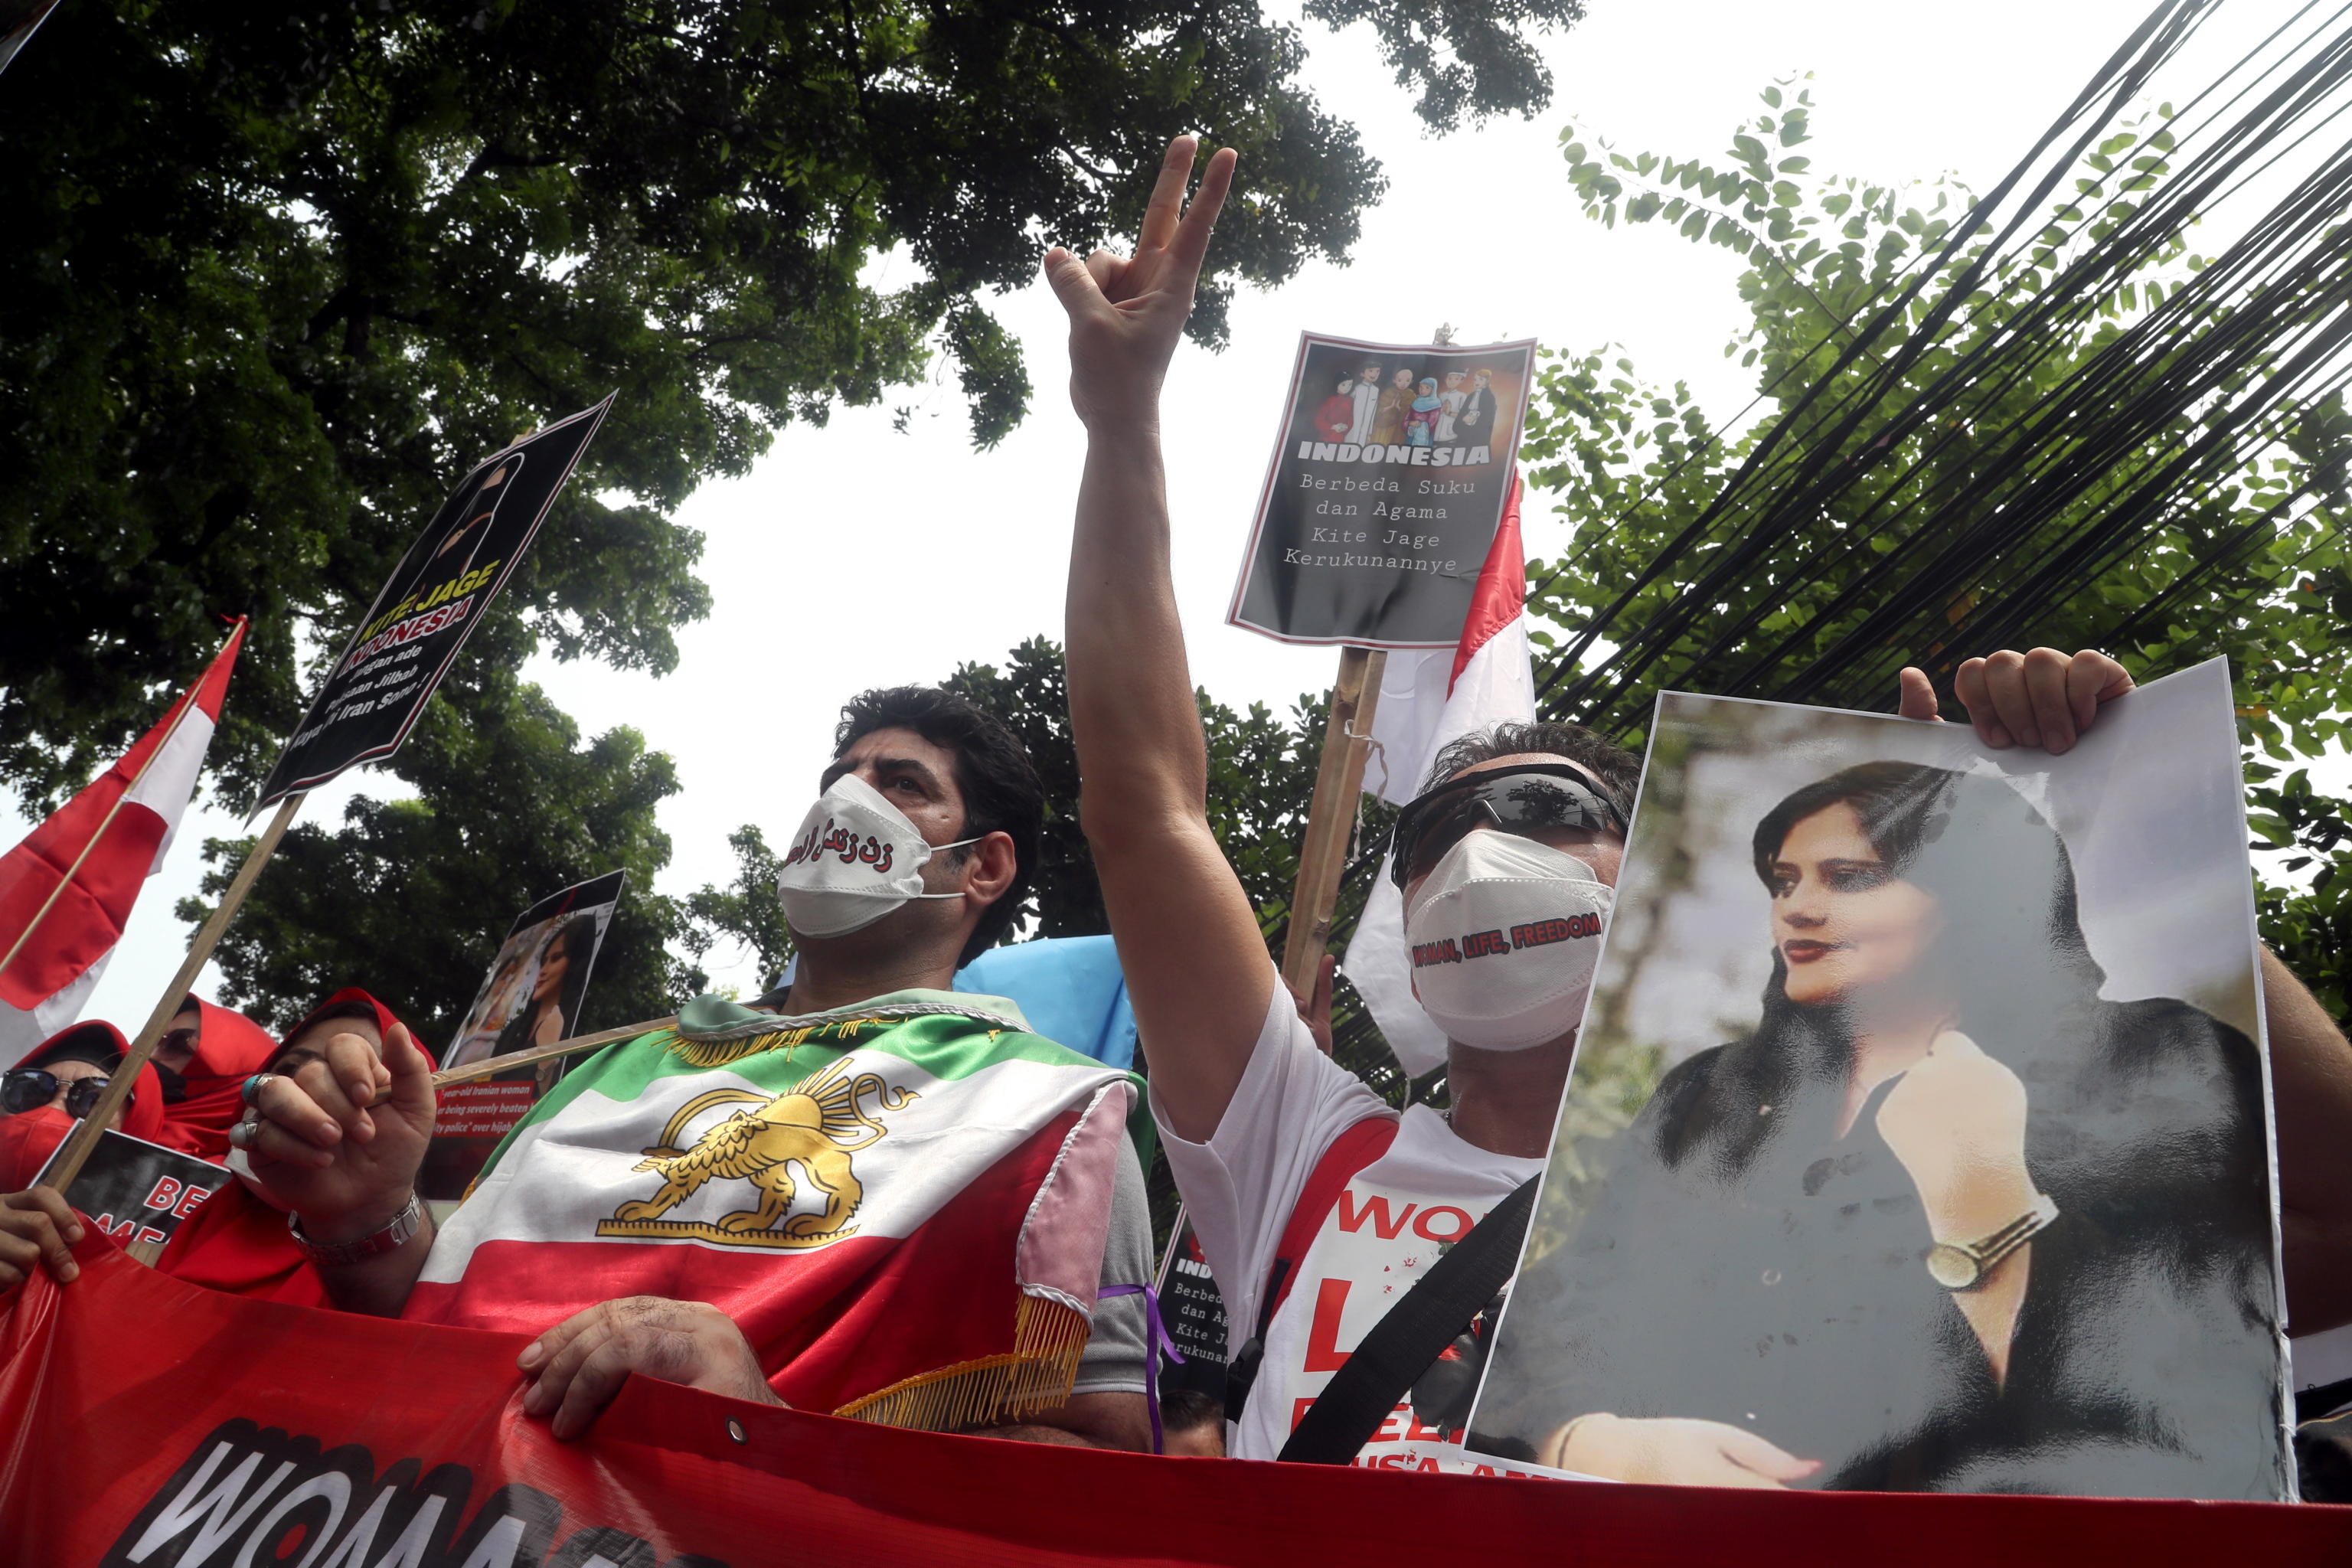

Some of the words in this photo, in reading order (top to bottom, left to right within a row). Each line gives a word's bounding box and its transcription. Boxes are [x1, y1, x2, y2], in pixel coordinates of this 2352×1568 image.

[1298, 440, 1491, 467] INDONESIA
[1299, 473, 1400, 493] Berbeda
[1417, 479, 1476, 495] Suku
[1315, 500, 1358, 516] dan
[1372, 501, 1448, 521] Agama
[1311, 527, 1367, 544] Kite
[1382, 530, 1440, 550] Jage
[1283, 547, 1457, 575] Kerukunannye
[356, 593, 419, 647] KITE
[415, 559, 501, 612] JAGE
[336, 593, 476, 680] INDONESIA
[394, 645, 423, 663] ade
[374, 664, 419, 689] Jilbab
[338, 700, 375, 722] Iran
[858, 835, 893, 874] زن
[1412, 938, 1463, 969] WOMAN,
[1462, 929, 1511, 959] LIFE,
[1509, 912, 1602, 950] FREEDOM
[472, 1085, 498, 1096] Iranian
[500, 1086, 530, 1095] woman
[445, 1106, 467, 1116] being
[466, 1105, 500, 1115] severely
[499, 1104, 528, 1113] beaten
[472, 1122, 489, 1132] over
[1338, 1190, 1489, 1243] WO
[1175, 1258, 1213, 1279] IND
[1181, 1305, 1206, 1319] dan
[1176, 1322, 1208, 1341] Kite
[126, 1441, 619, 1568] WOM
